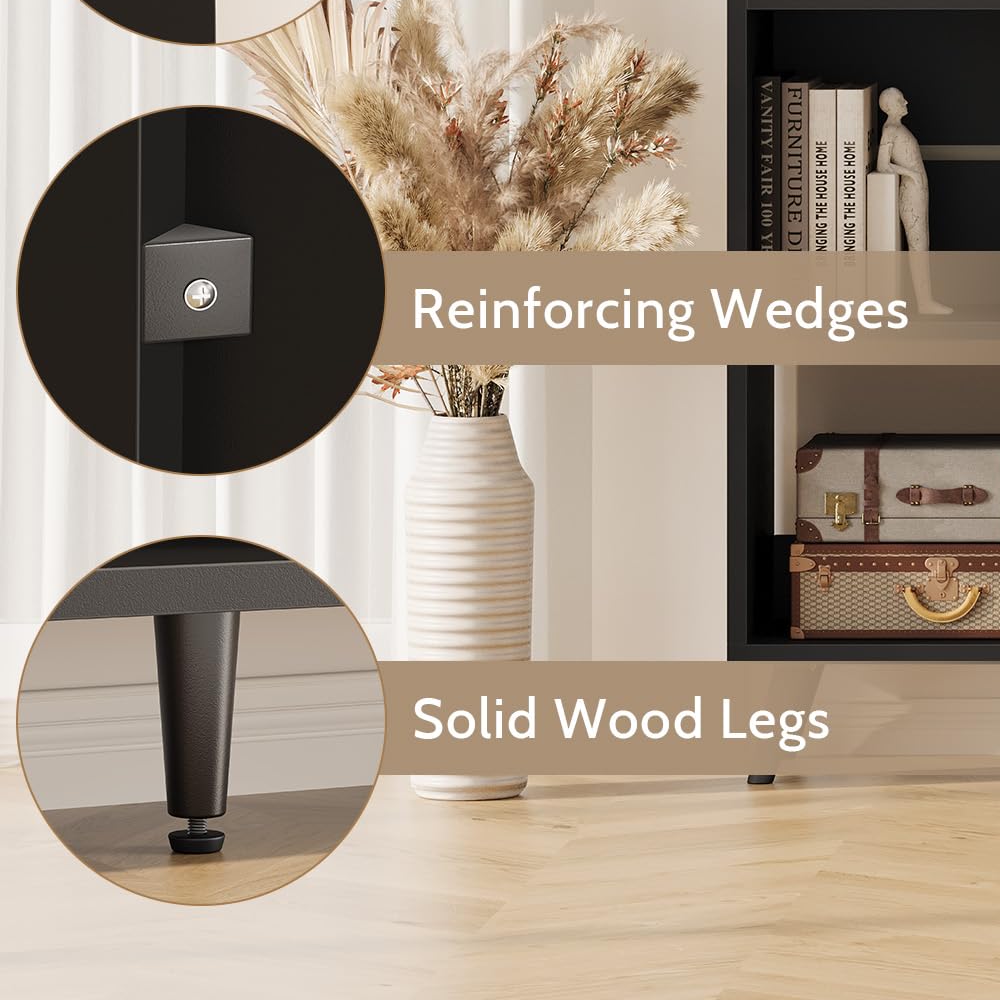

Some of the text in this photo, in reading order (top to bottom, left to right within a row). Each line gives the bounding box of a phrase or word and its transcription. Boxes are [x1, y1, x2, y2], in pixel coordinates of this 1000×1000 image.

[760, 81, 774, 148] VANITY
[788, 87, 802, 223] FURNITURE
[815, 141, 827, 166] HOME
[843, 141, 856, 166] HOME
[761, 154, 773, 195] FAIR
[815, 169, 827, 200] HOUSE
[843, 169, 856, 200] HOUSE
[761, 202, 773, 226] 100
[815, 202, 827, 219] THE
[843, 202, 856, 219] THE
